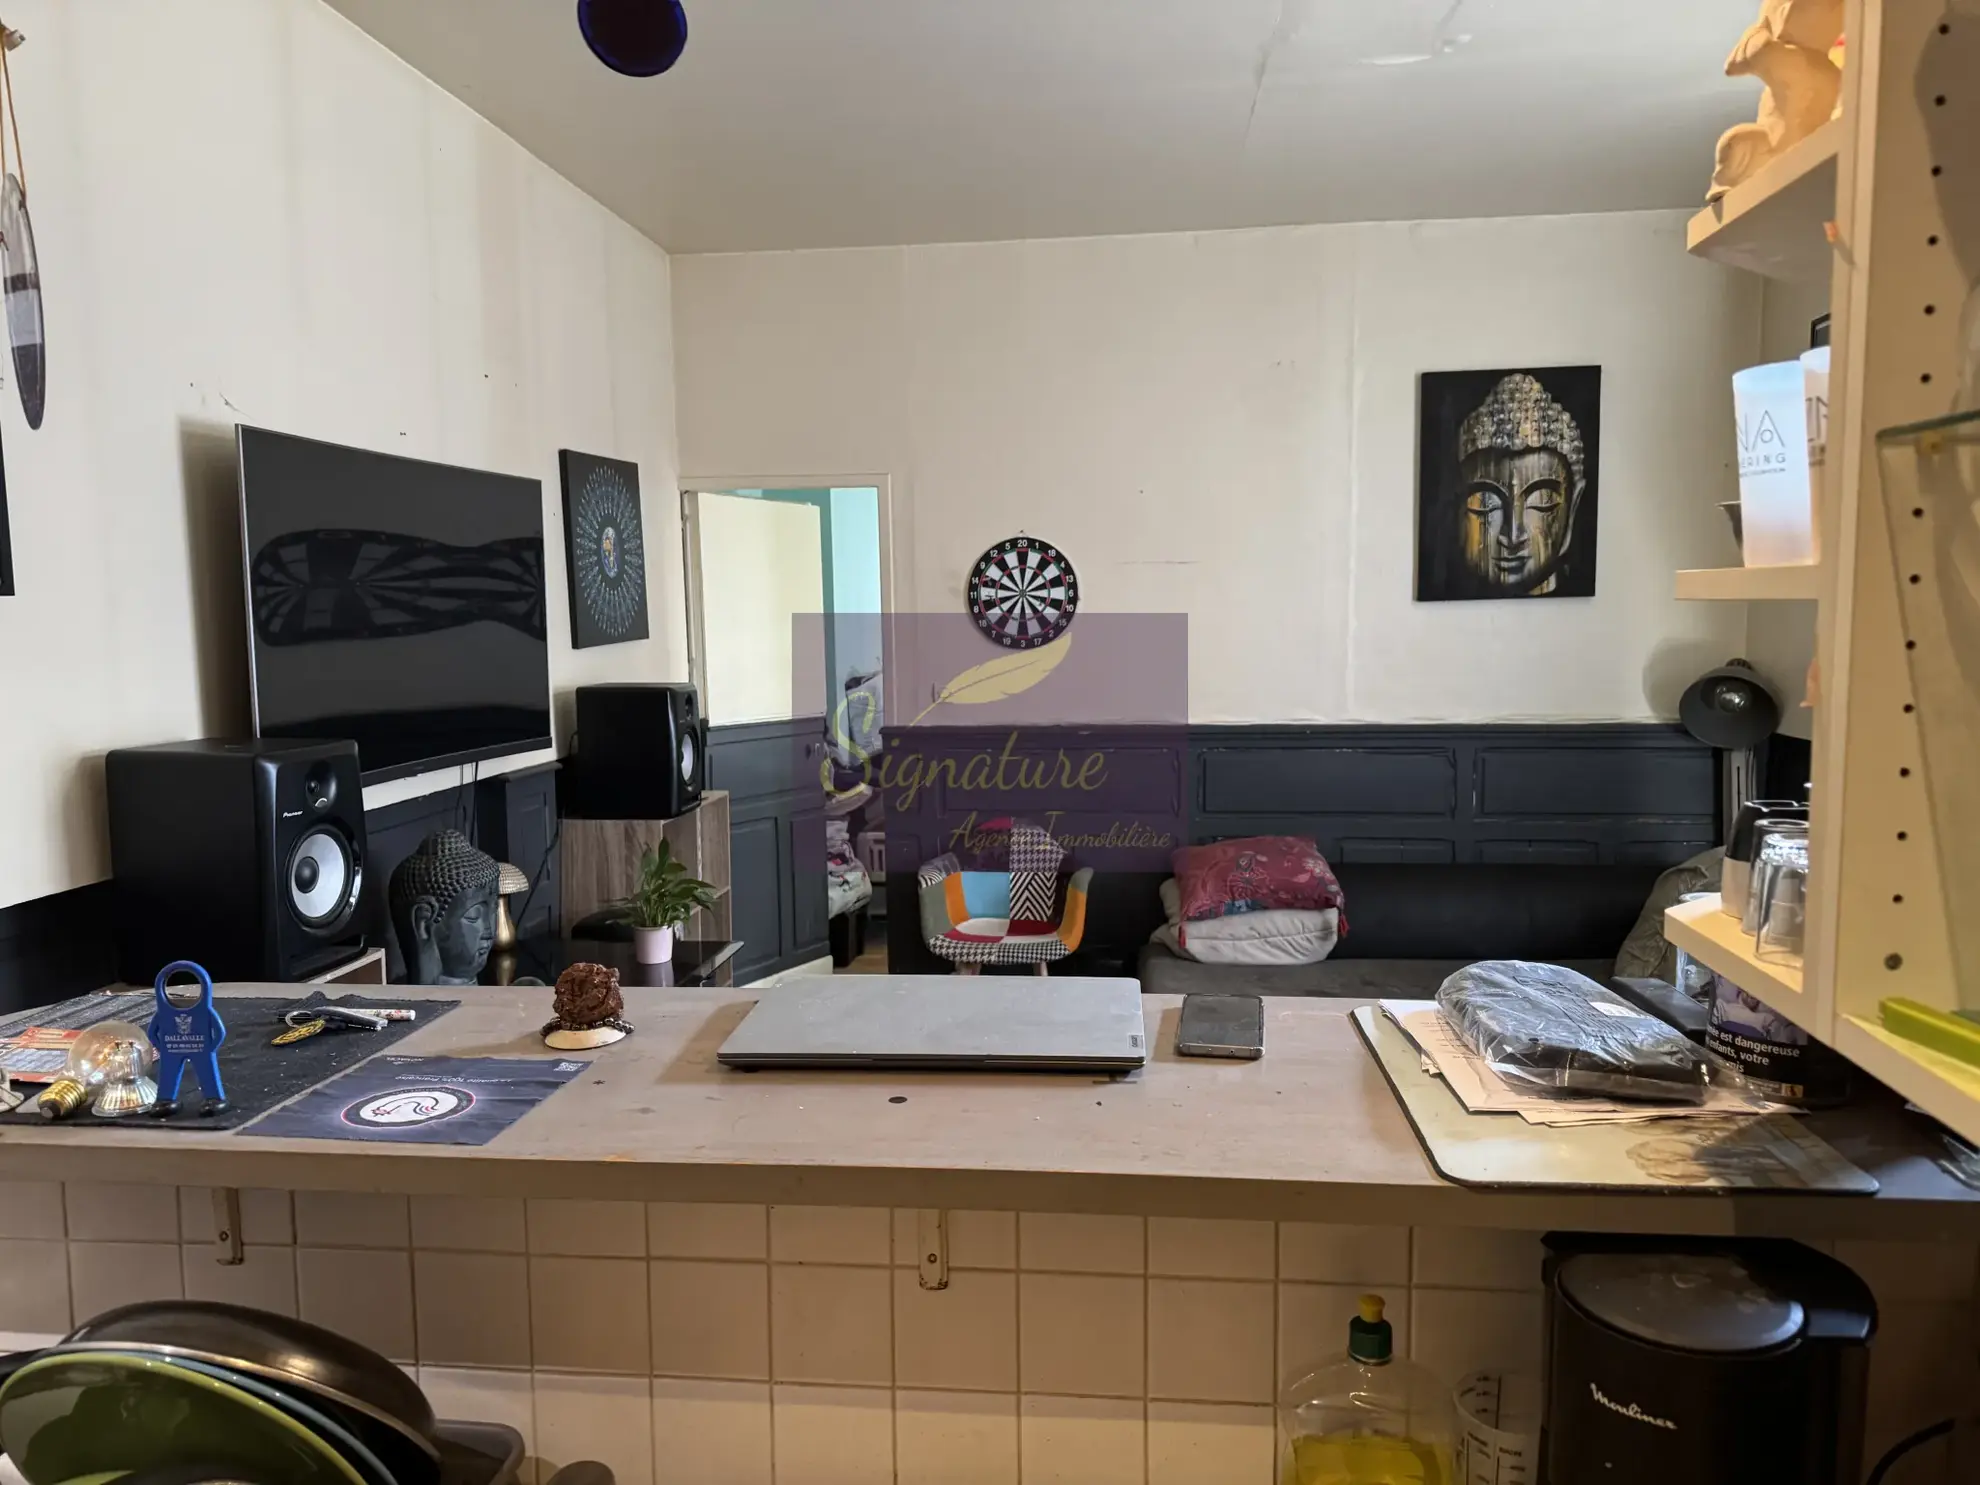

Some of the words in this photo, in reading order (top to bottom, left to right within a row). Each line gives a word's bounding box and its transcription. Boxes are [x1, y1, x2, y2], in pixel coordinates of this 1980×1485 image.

[1047, 549, 1056, 557] 18
[1066, 575, 1074, 583] 13
[164, 1034, 205, 1042] DALLAVALLE
[1720, 1030, 1733, 1043] est
[1735, 1036, 1800, 1057] dangereuse
[1740, 1051, 1770, 1066] votre
